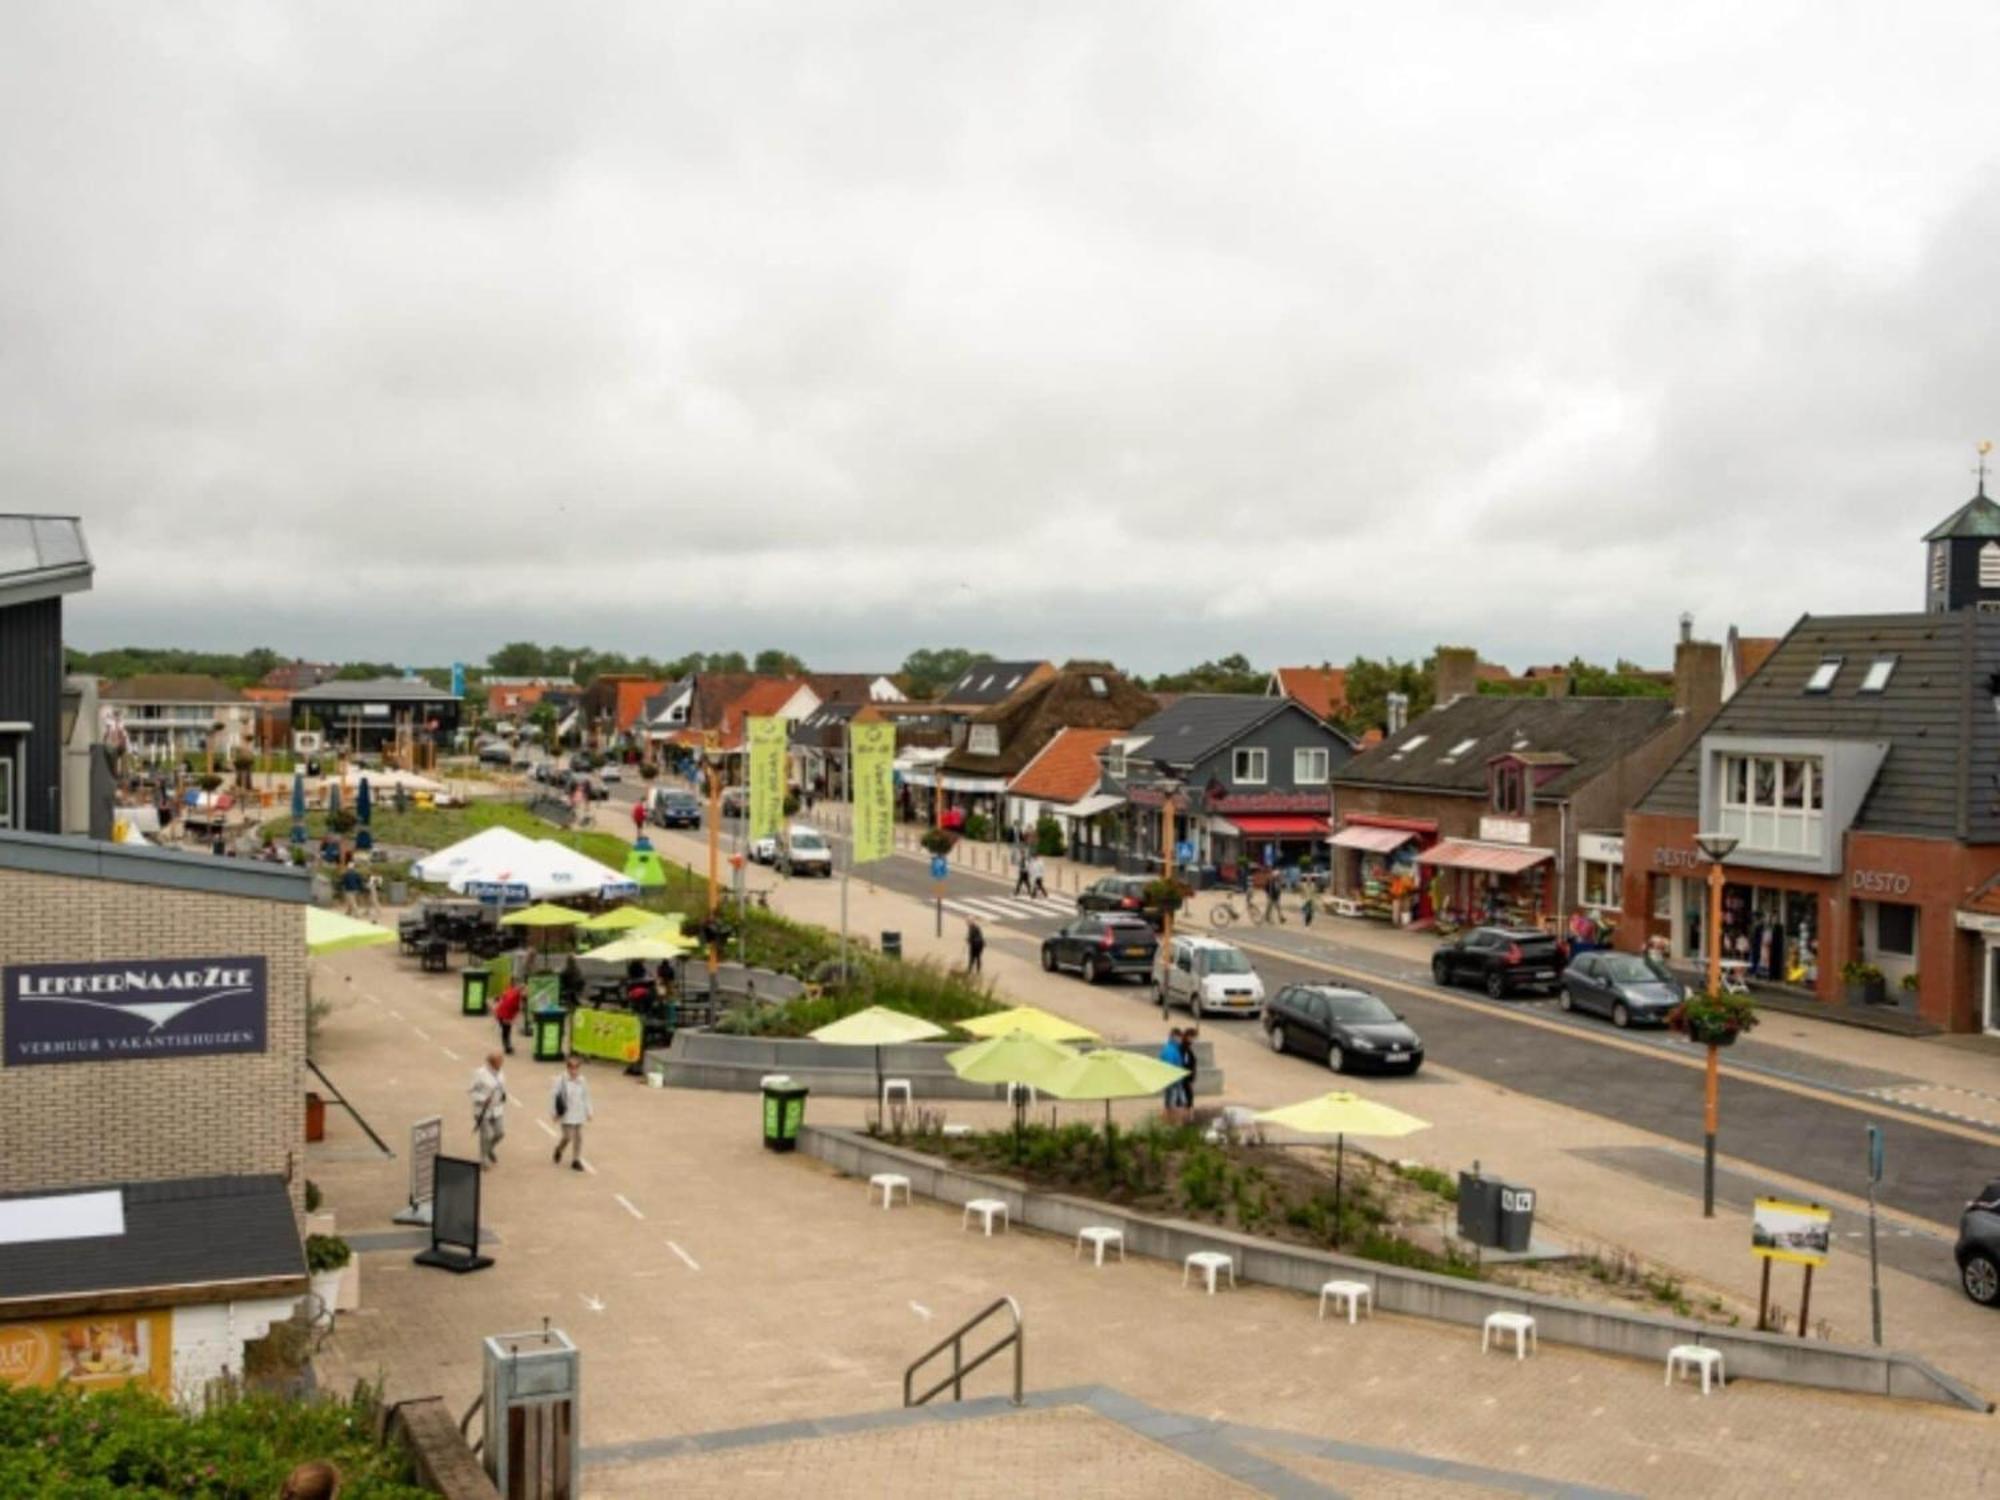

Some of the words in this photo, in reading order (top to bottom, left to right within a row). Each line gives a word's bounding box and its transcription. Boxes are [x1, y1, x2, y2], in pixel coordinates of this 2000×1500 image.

[1854, 870, 1910, 894] DESTO
[19, 1038, 99, 1054] VERHUUR
[107, 1032, 255, 1051] VAKANTIEHUIZEN
